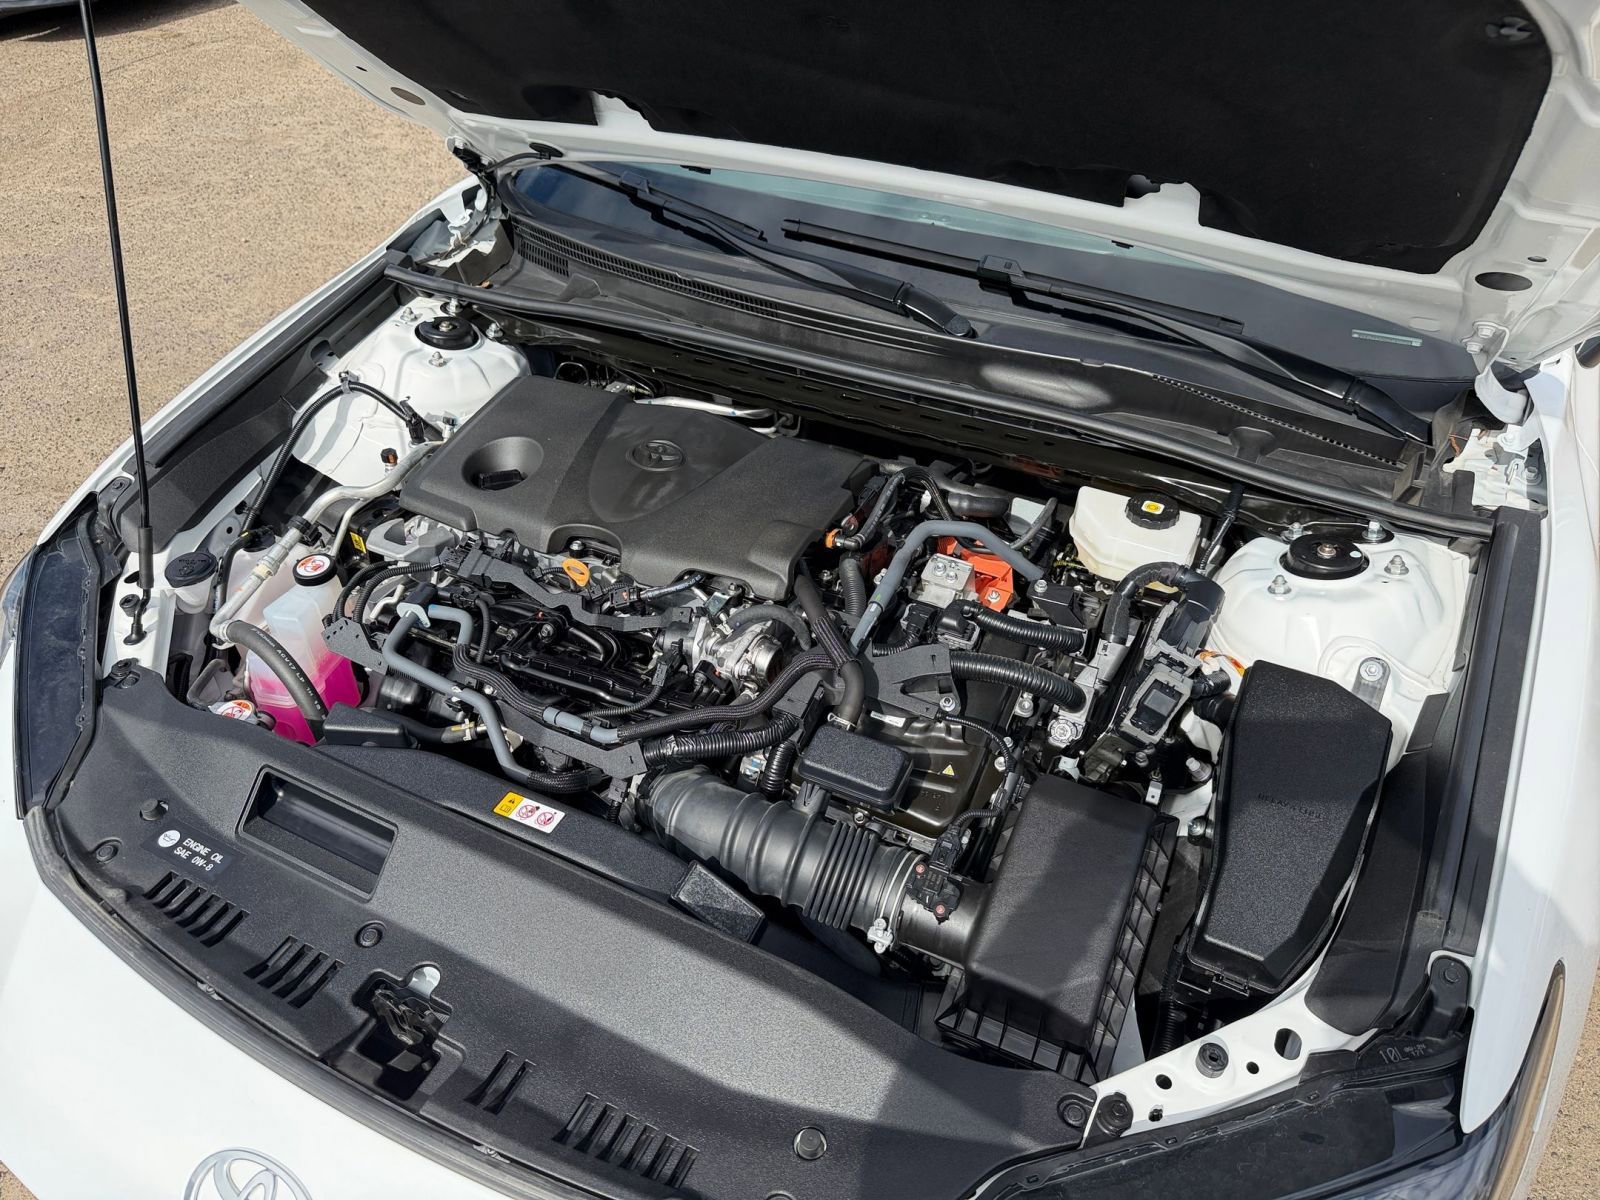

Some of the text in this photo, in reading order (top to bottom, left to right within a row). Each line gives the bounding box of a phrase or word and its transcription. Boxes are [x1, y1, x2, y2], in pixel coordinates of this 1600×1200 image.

[174, 846, 214, 871] SAE 0W-8
[183, 838, 224, 864] ENGINE OIL
